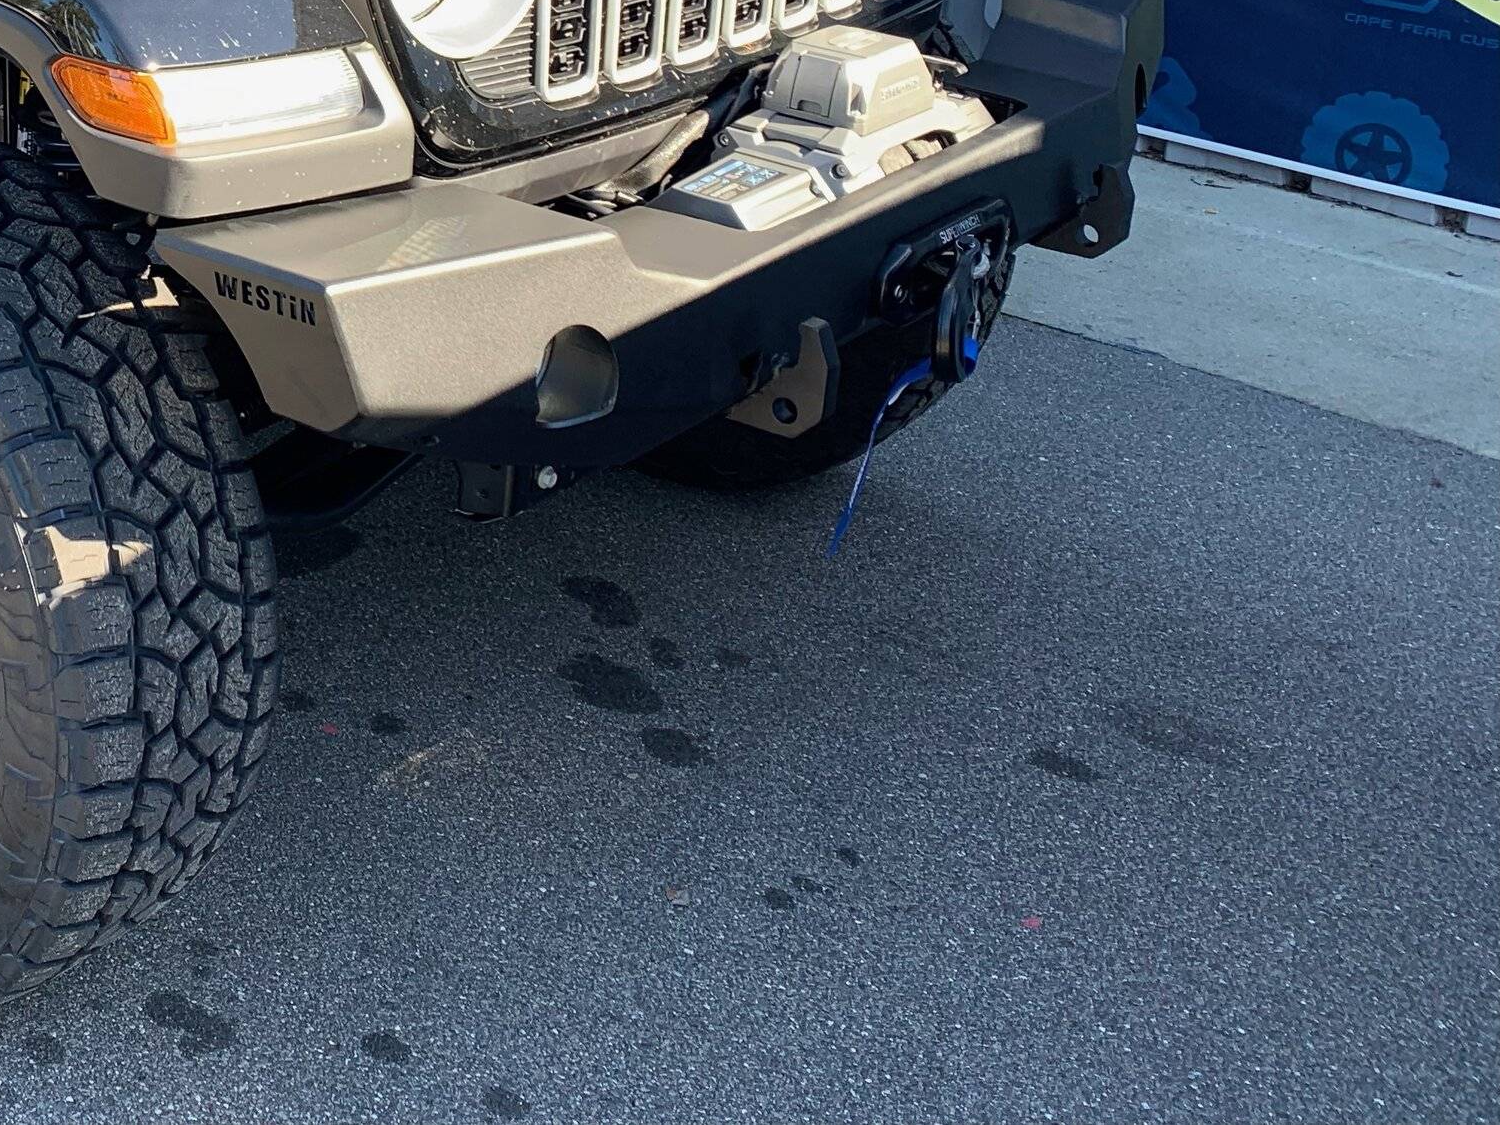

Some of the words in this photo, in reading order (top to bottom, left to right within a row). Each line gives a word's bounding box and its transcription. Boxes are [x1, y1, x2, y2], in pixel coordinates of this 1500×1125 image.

[1344, 13, 1393, 30] CAPE
[1400, 22, 1451, 40] FEAR
[939, 214, 980, 245] SUPERWINCH
